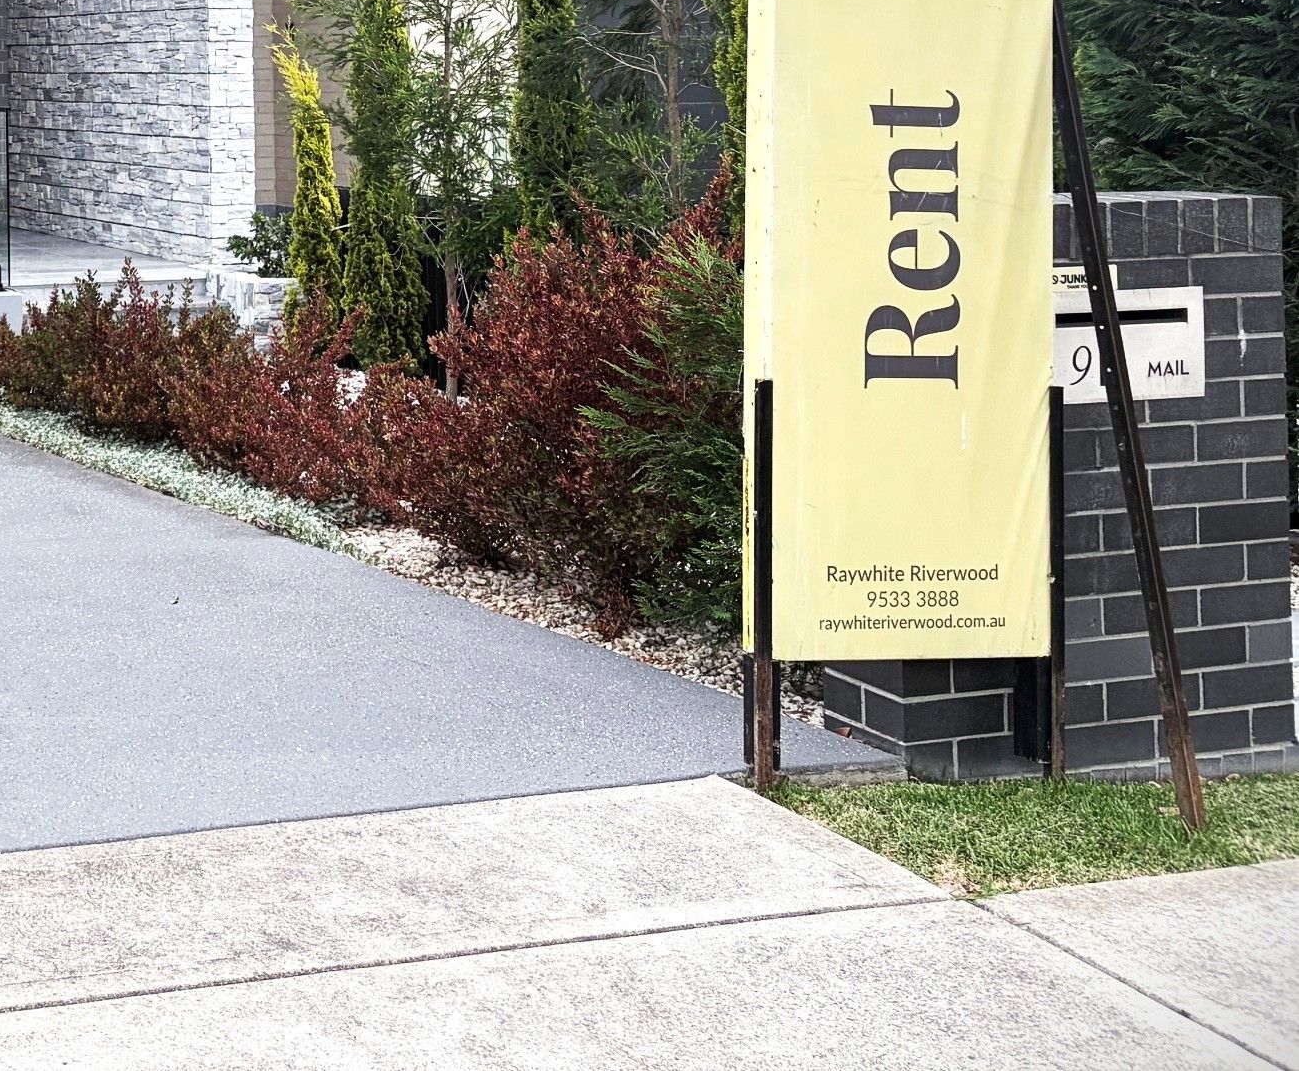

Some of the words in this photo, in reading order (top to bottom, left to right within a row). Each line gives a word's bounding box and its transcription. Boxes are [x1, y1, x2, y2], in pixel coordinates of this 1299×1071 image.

[864, 88, 961, 390] Rent
[1147, 359, 1190, 378] MAIL
[827, 565, 905, 585] Raywhite
[910, 564, 999, 582] Riverwood
[867, 591, 911, 608] 9533
[916, 590, 959, 608] 3888
[819, 614, 1006, 633] raywhiteriverwood.com.au
